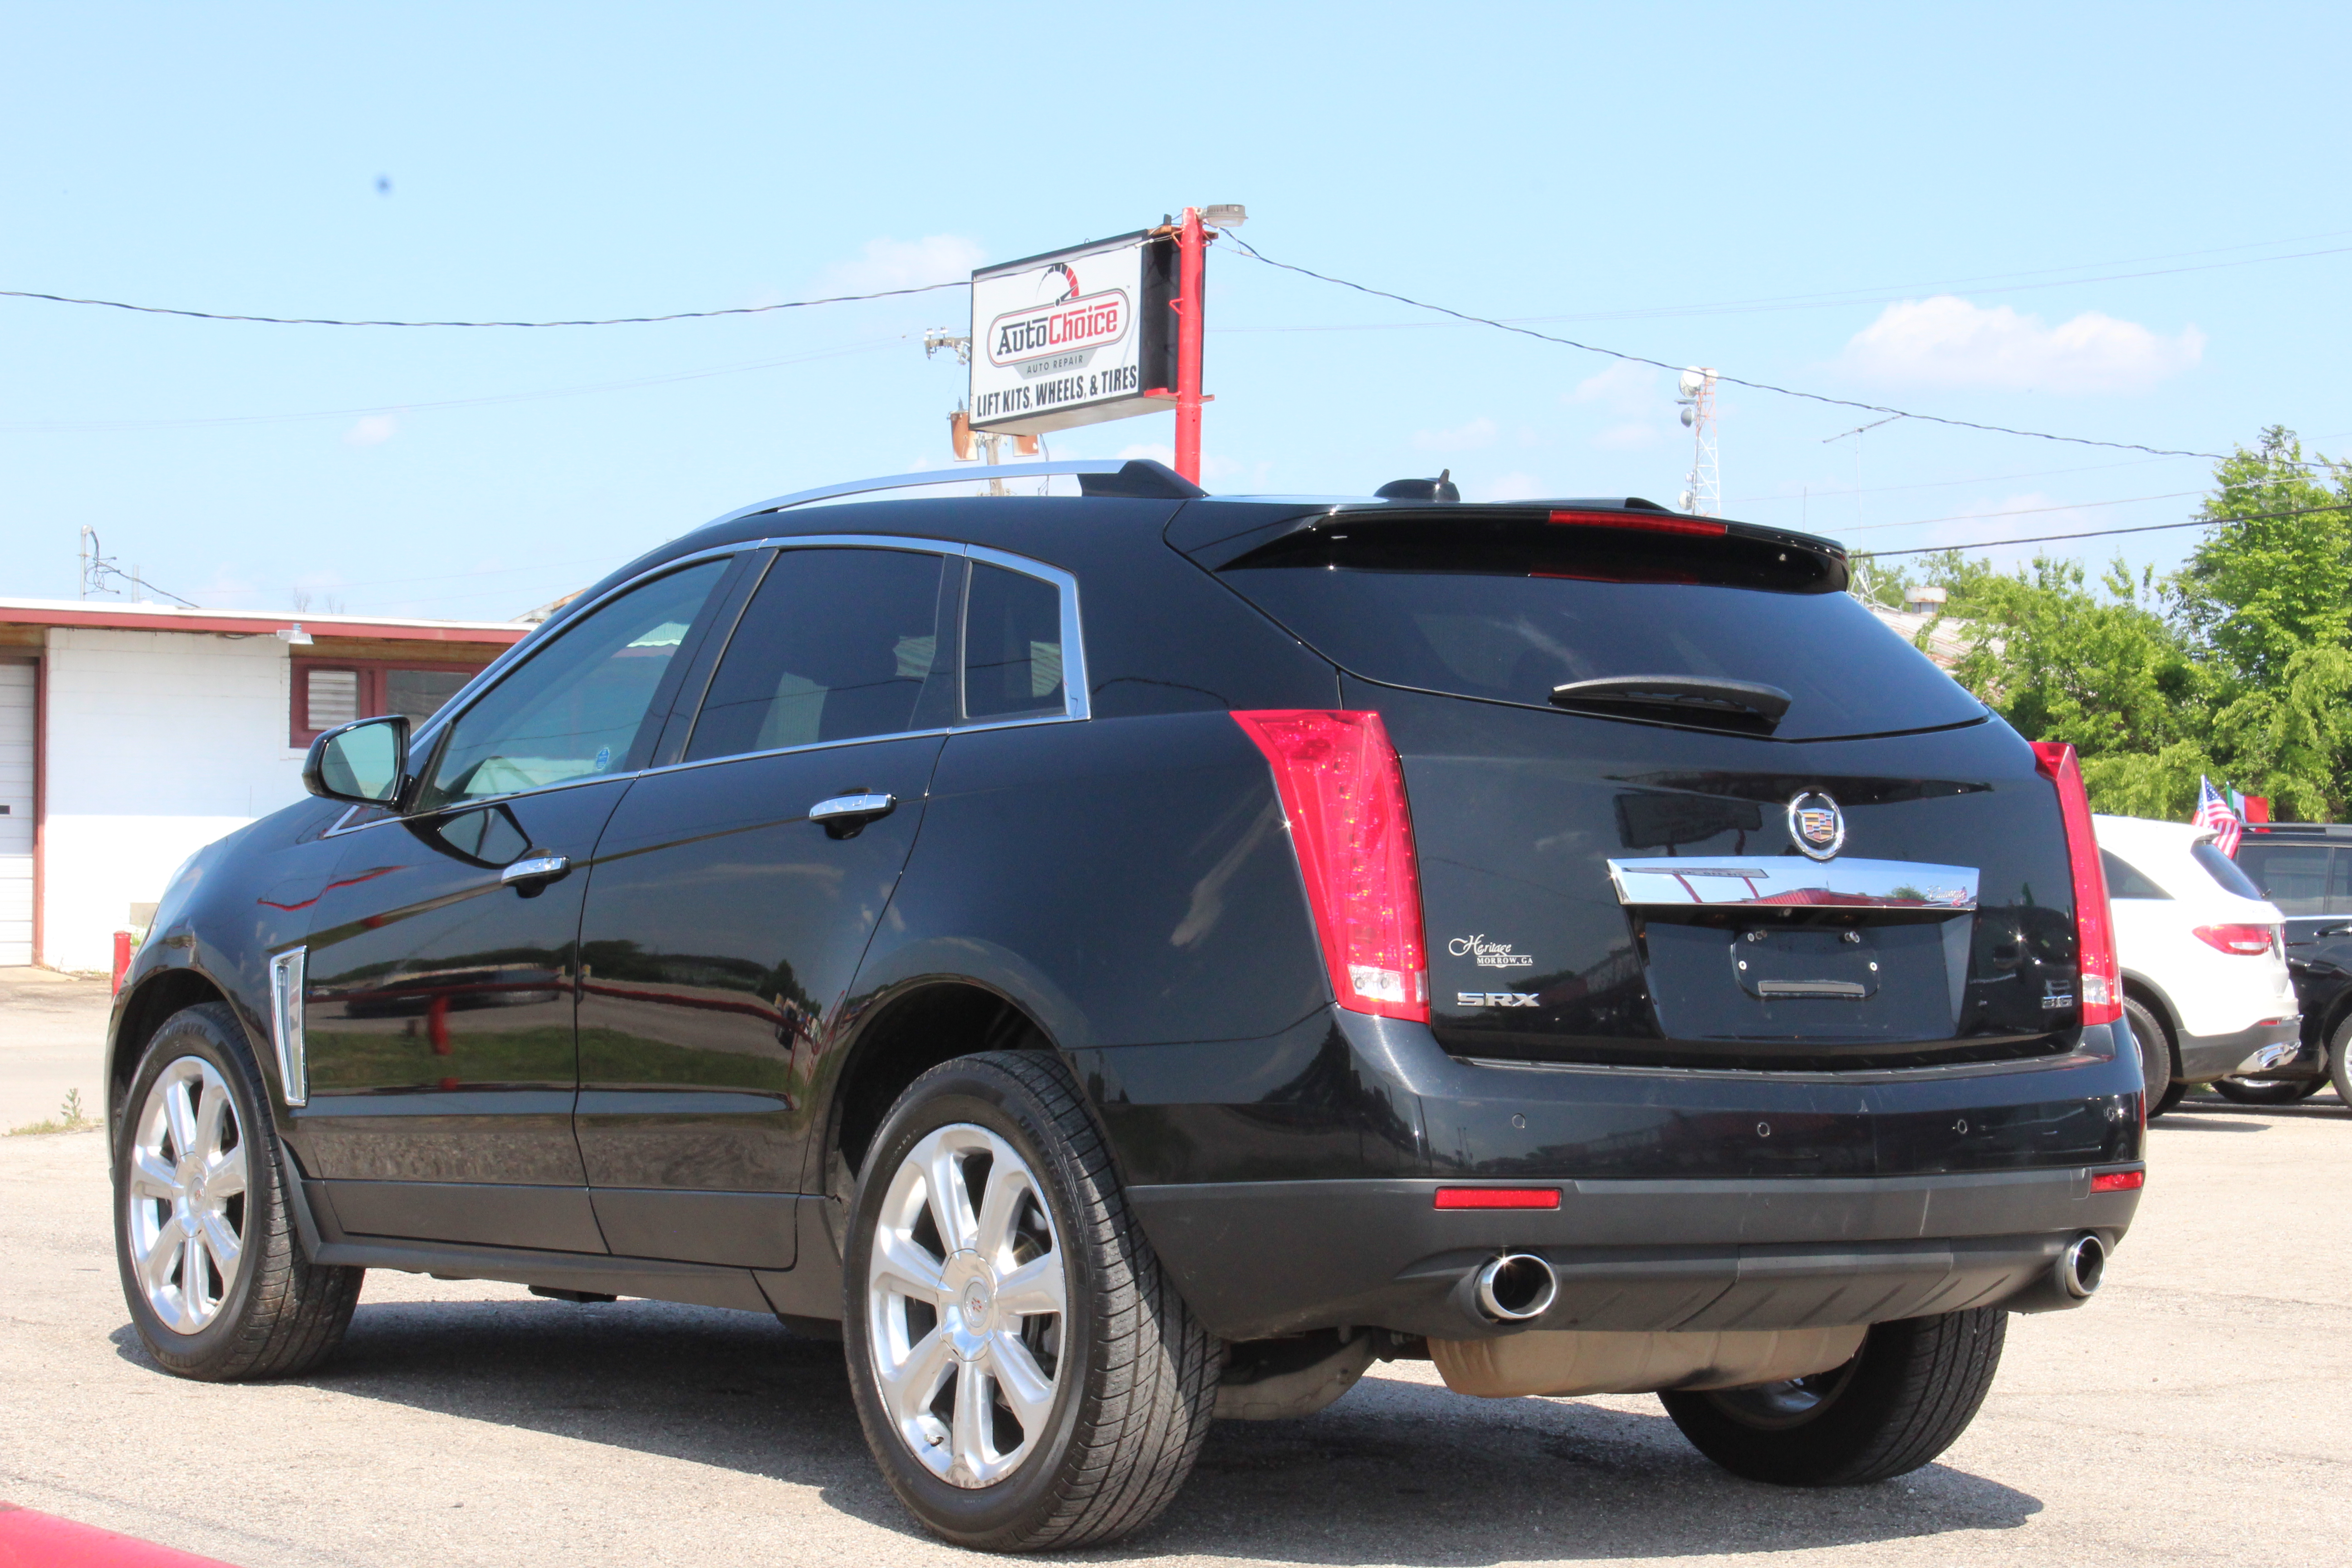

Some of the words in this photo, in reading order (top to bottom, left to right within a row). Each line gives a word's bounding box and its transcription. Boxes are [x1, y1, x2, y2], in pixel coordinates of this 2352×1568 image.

[997, 301, 1119, 355] AutoChoice
[1027, 363, 1049, 374] AUTO
[1053, 355, 1083, 369] REPAIR
[977, 392, 1000, 417] LIFT
[1003, 386, 1033, 412] KITS,
[1036, 376, 1087, 406] WHEELS,
[1089, 375, 1098, 396] &
[1102, 365, 1137, 394] TIRES
[1448, 934, 1512, 956] Heritage
[1457, 992, 1540, 1007] SRX
